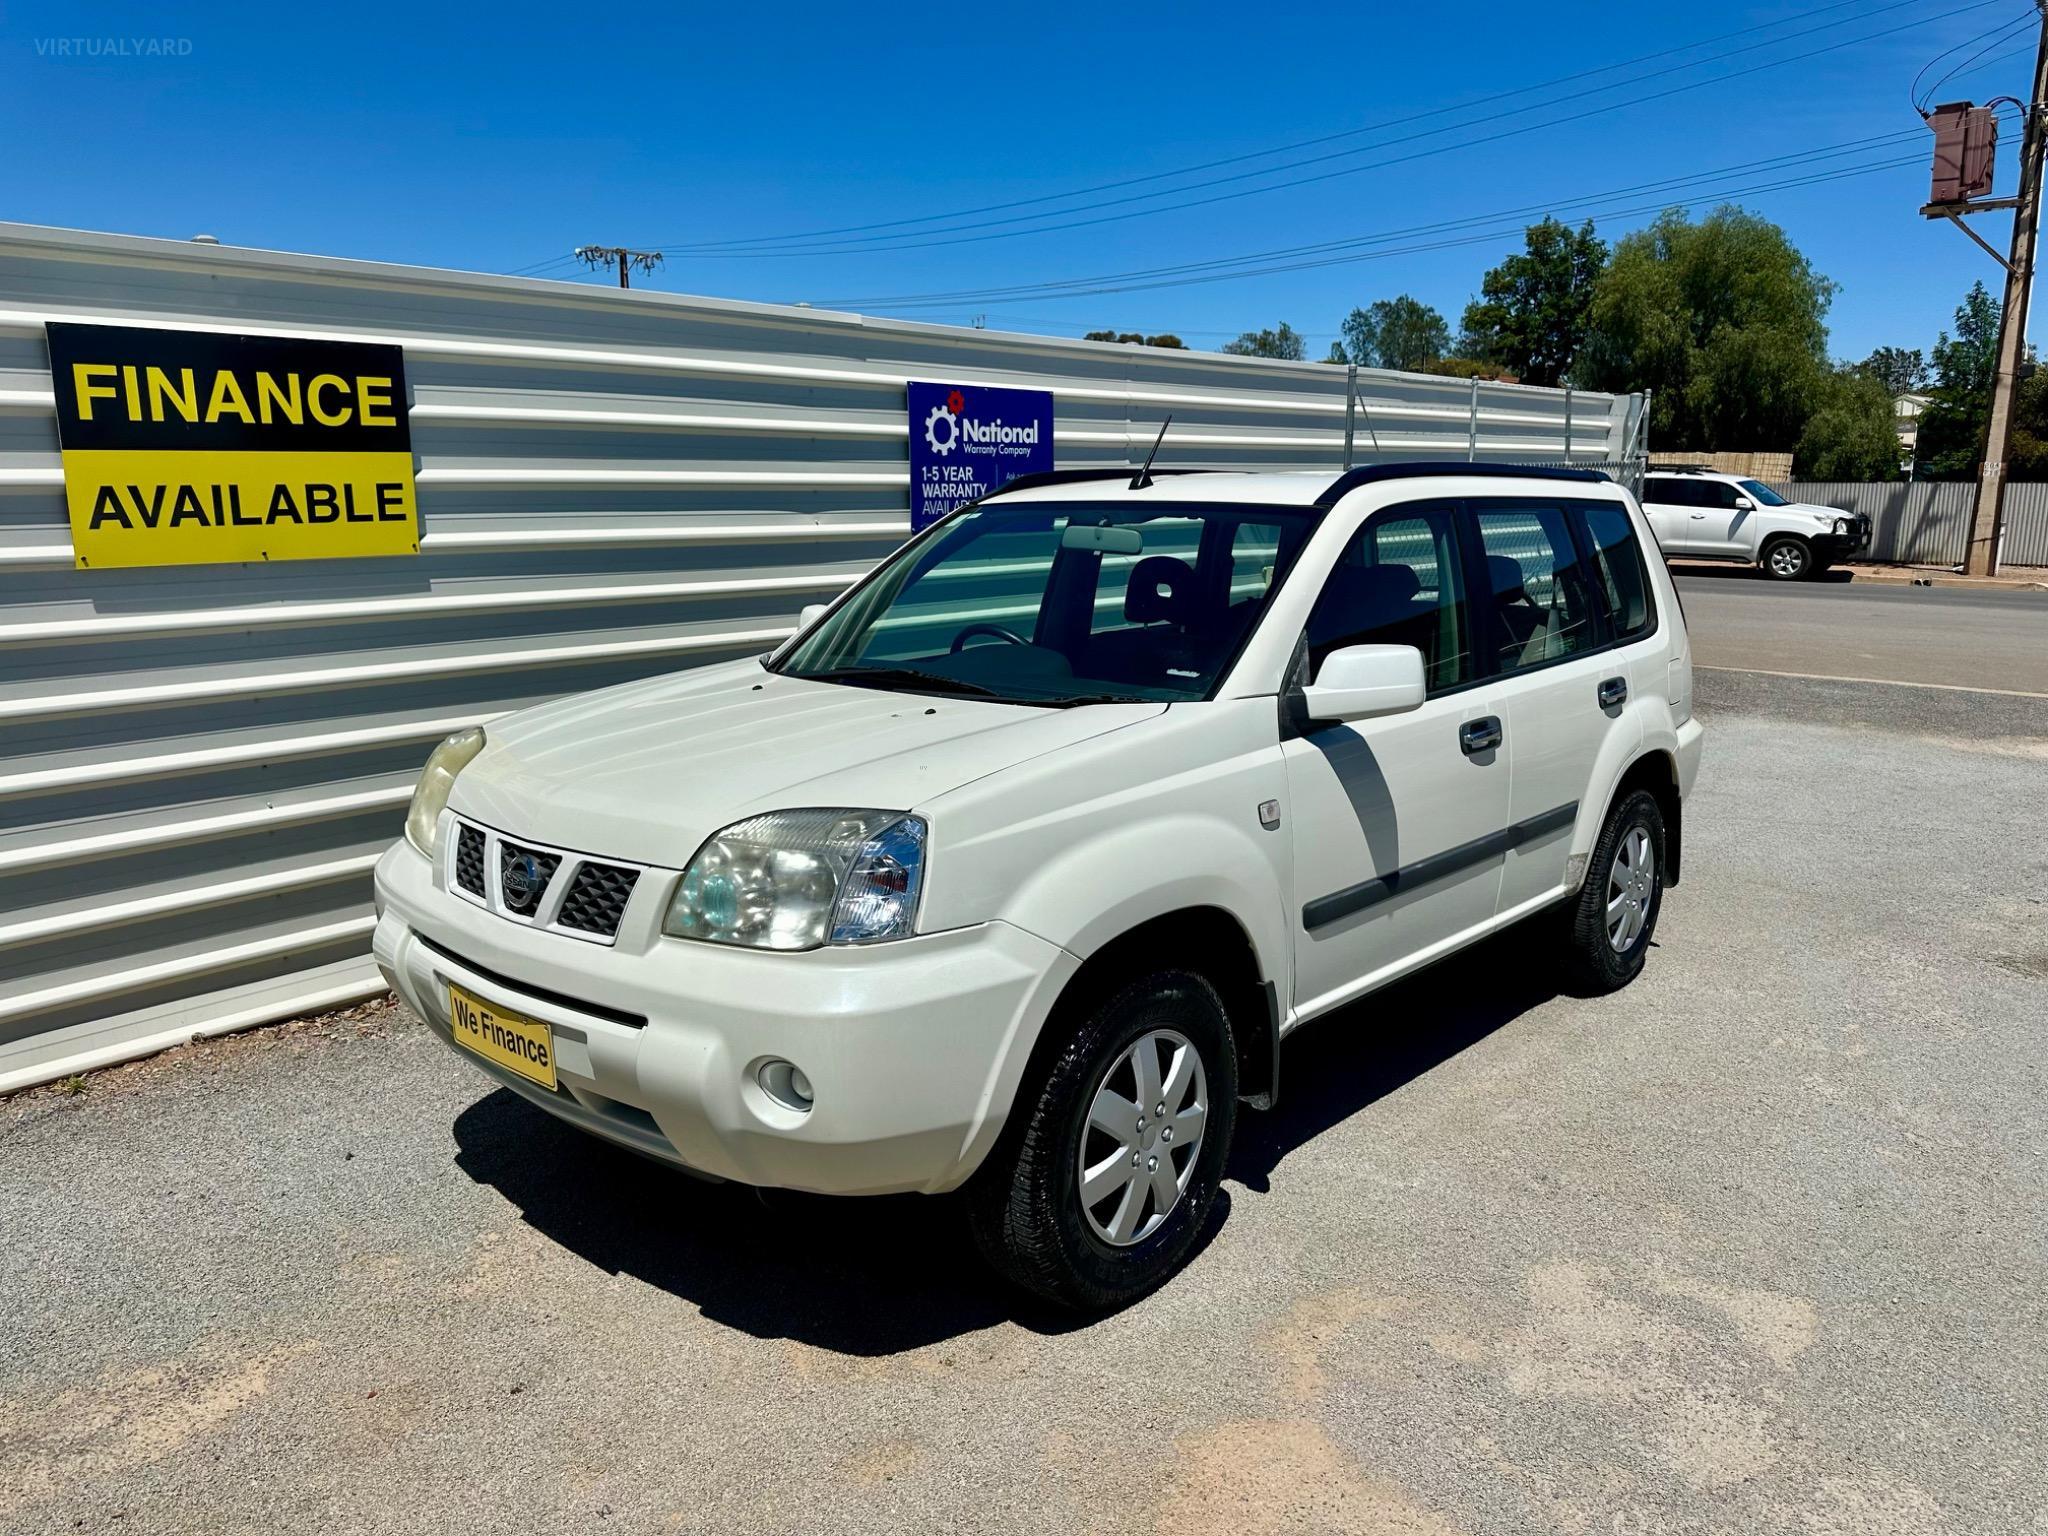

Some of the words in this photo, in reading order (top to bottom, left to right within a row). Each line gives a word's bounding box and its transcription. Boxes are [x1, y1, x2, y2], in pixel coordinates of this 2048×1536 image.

[72, 363, 397, 427] FINANCE
[962, 418, 1039, 444] National
[963, 443, 997, 457] Warranty
[999, 444, 1031, 458] Company
[921, 466, 939, 481] 1-5
[942, 466, 974, 481] YEAR
[921, 483, 987, 498] WARRANTY
[89, 483, 407, 530] AVAILABLE
[453, 997, 479, 1035] We
[480, 1011, 548, 1068] Finance
